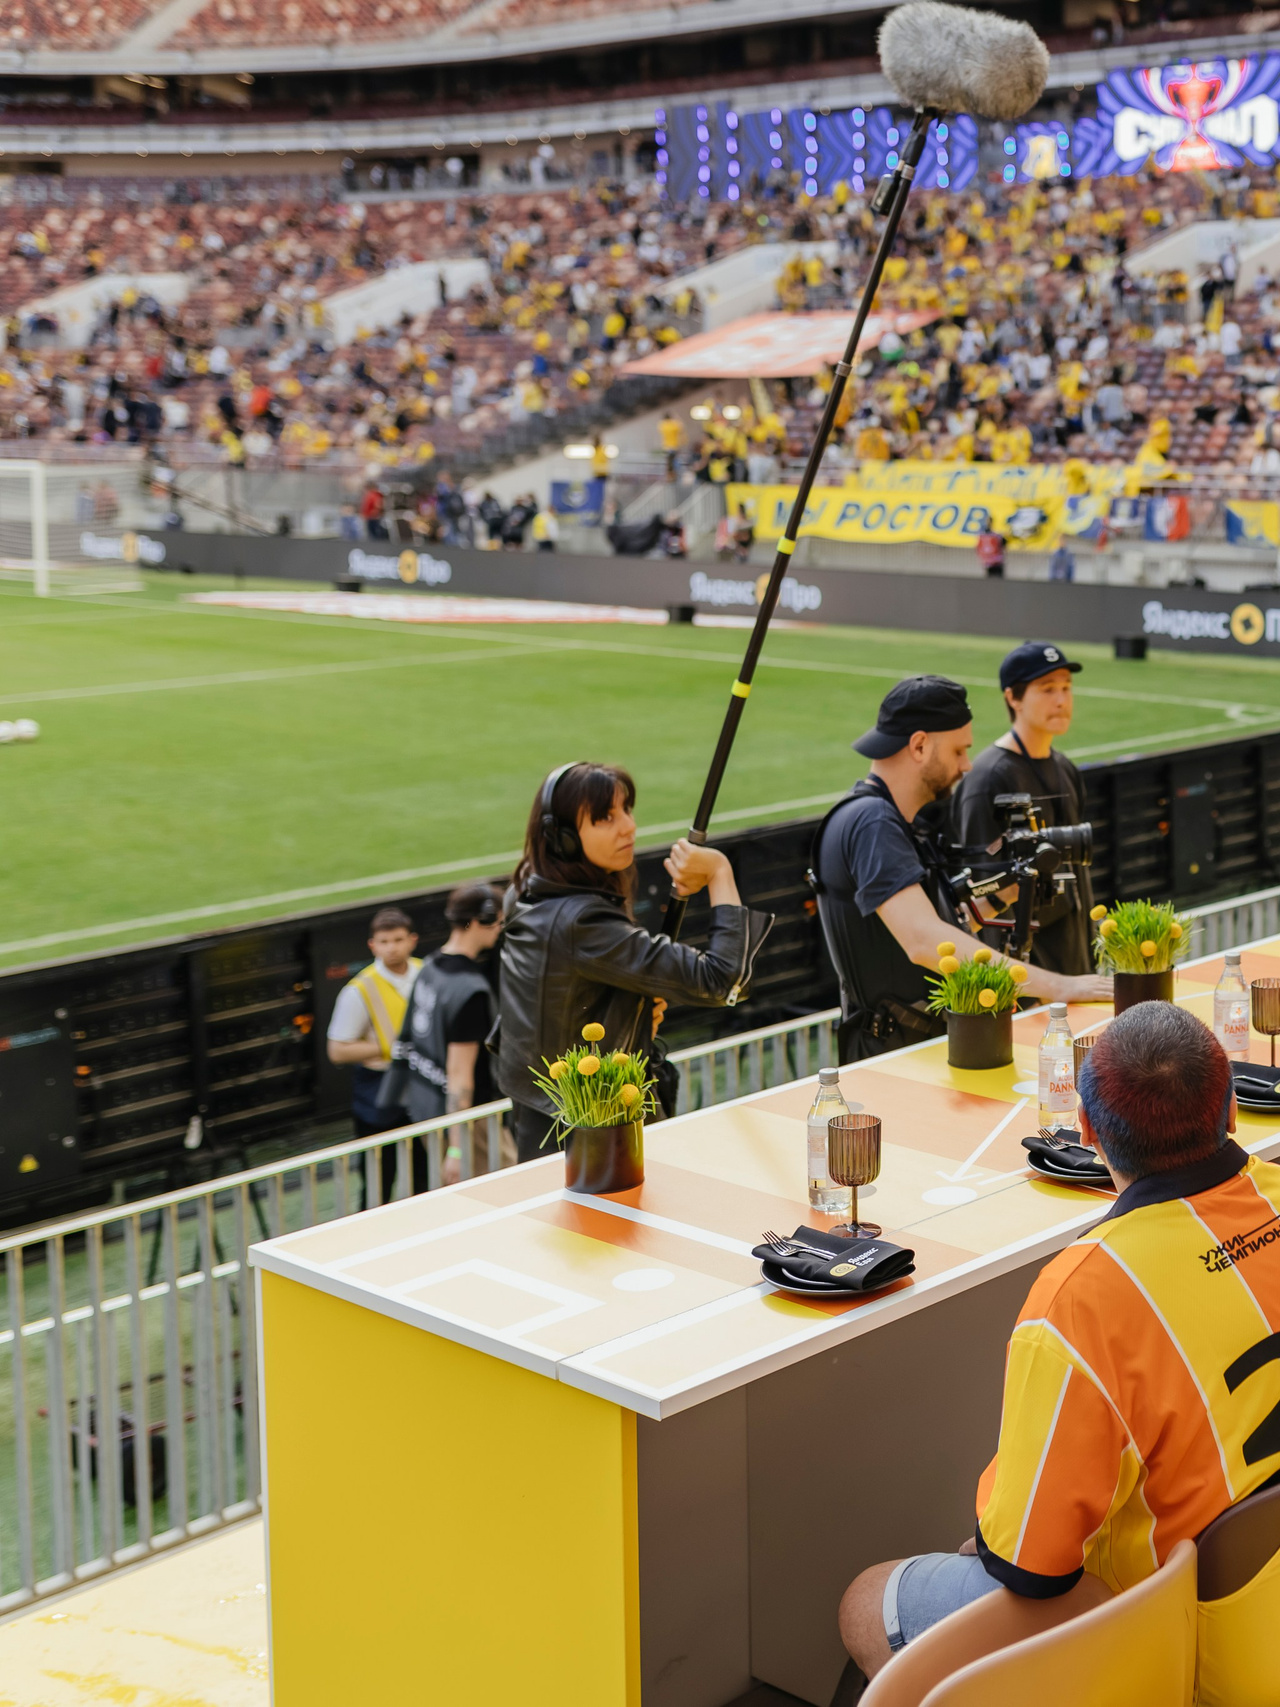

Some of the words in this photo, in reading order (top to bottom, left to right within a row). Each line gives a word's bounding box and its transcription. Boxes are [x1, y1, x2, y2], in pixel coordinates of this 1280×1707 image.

[835, 501, 990, 535] РОСТОВ
[1142, 600, 1231, 640] Яндекс
[1043, 647, 1060, 662] S
[972, 881, 1000, 896] RONIN
[1050, 1081, 1074, 1093] PANN
